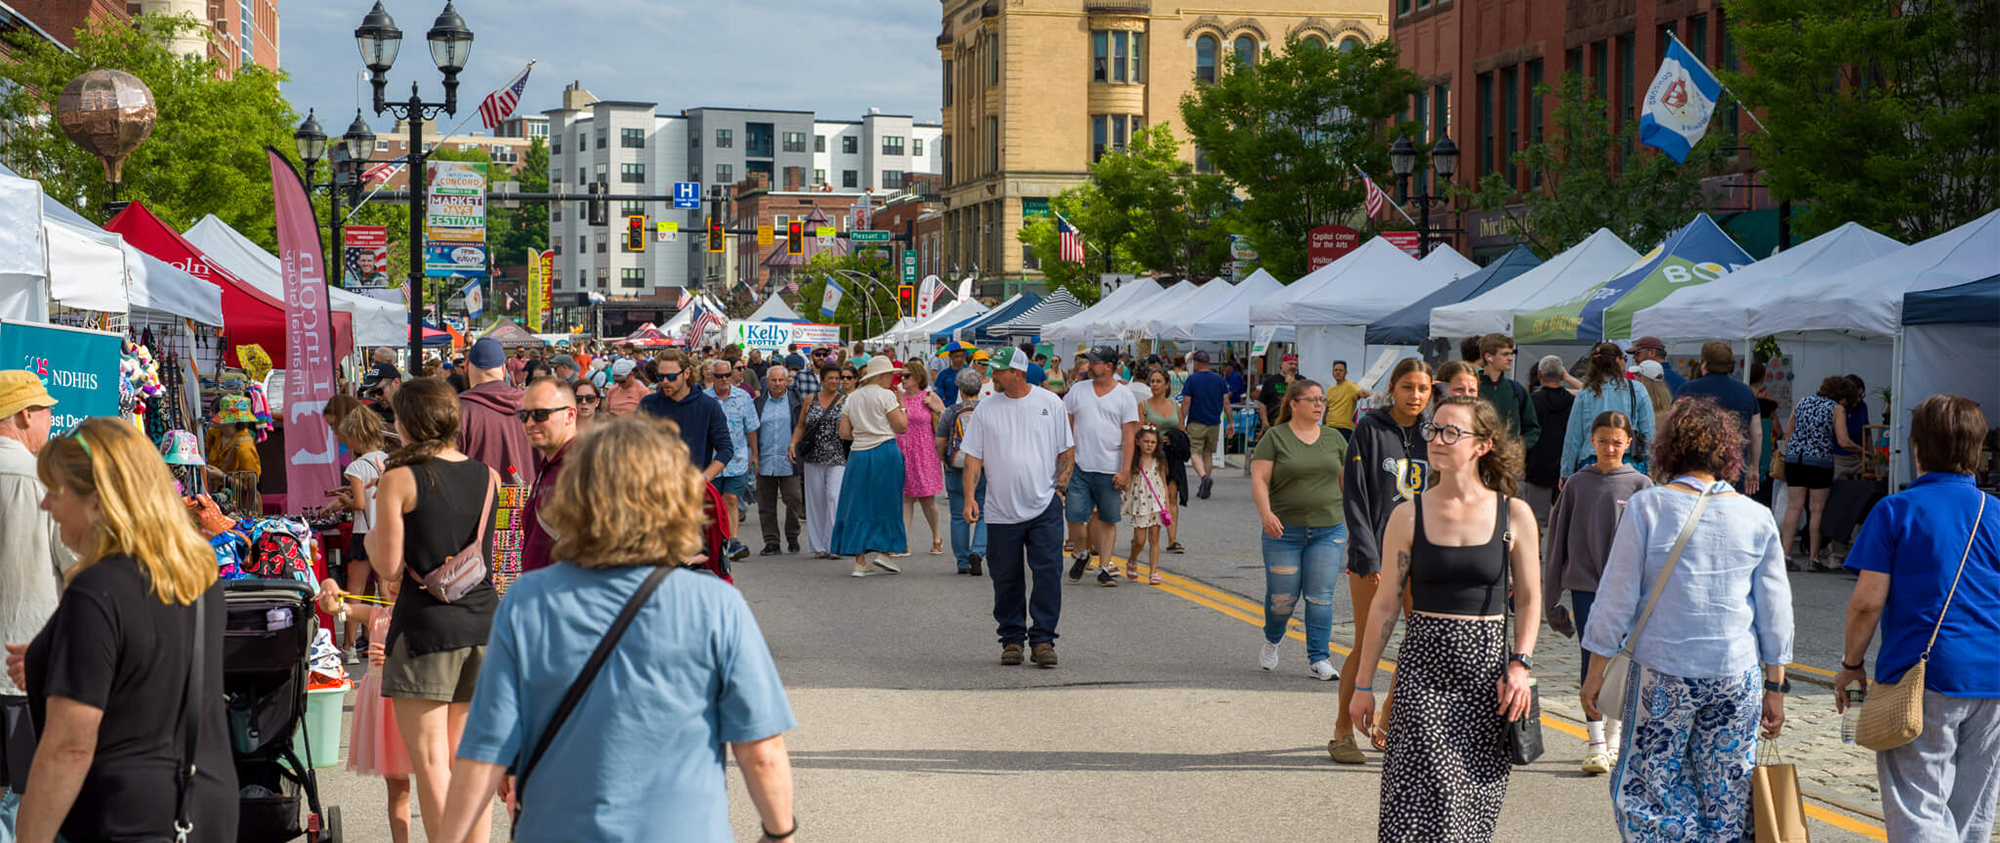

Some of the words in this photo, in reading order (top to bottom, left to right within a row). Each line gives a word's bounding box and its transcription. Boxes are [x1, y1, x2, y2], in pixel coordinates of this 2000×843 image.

[441, 178, 479, 186] CONCORD
[681, 183, 692, 198] H
[430, 195, 482, 206] MARKET
[443, 205, 473, 215] DAYS
[430, 216, 483, 226] FESTIVAL
[1312, 256, 1332, 264] Visitor
[541, 257, 551, 309] KETTLE
[747, 325, 788, 345] Kelly
[52, 369, 98, 390] NDHHS
